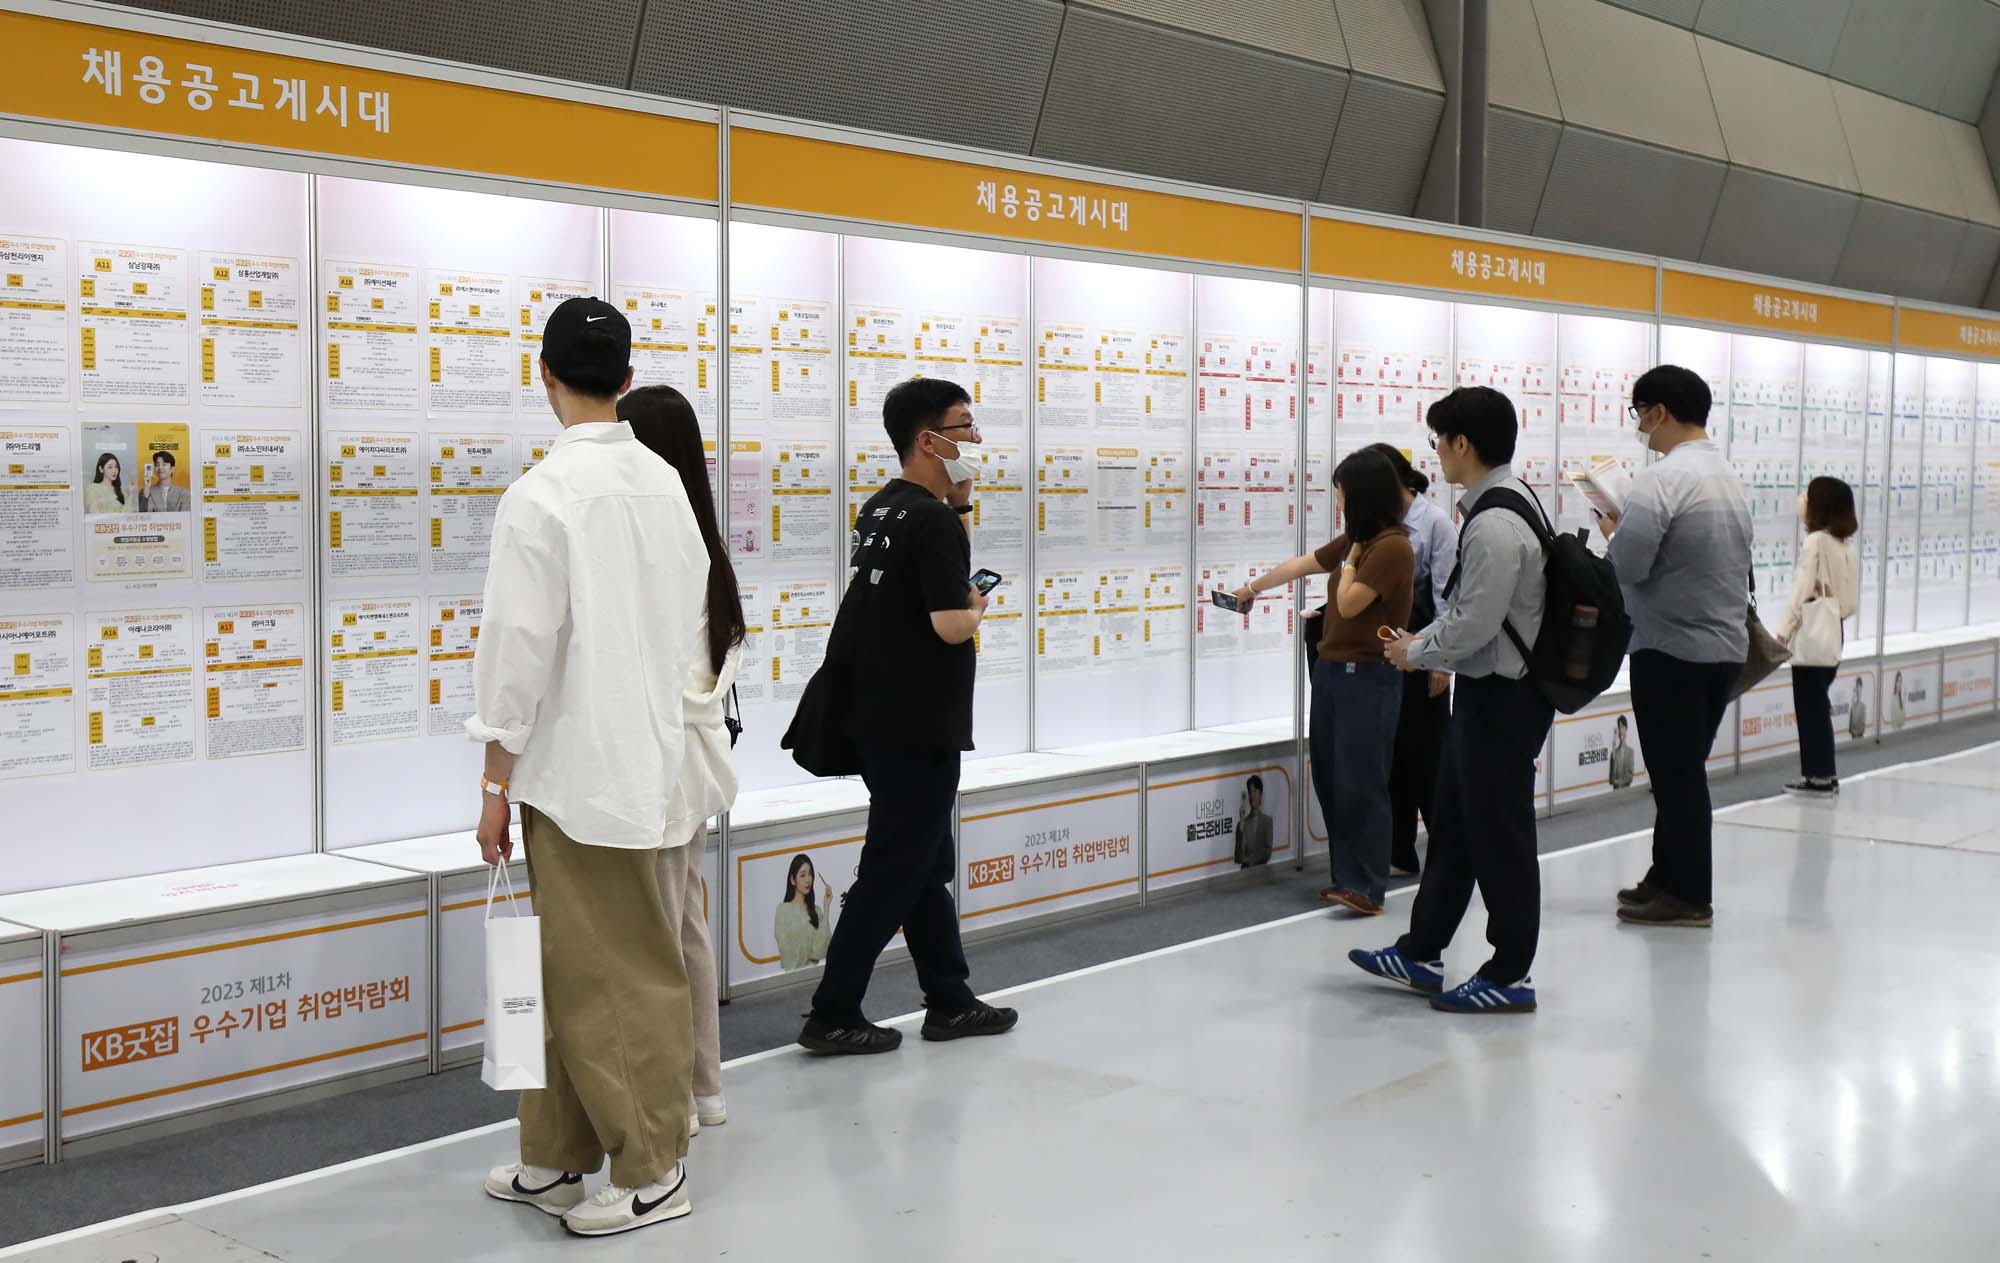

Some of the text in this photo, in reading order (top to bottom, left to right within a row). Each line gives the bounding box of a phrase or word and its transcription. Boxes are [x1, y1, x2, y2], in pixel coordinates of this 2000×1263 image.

[82, 47, 391, 134] 채용공고게시대
[976, 180, 1128, 232] 채용공고게시대
[1450, 249, 1545, 285] 채용공고게시대
[1196, 799, 1224, 819] 내일의
[1025, 828, 1070, 848] 2023 제1차
[1186, 817, 1233, 842] 출근준비로
[969, 835, 1130, 886] KB굿잡 우수기업 취업박람회
[200, 971, 292, 1005] 2023 제1차
[83, 975, 410, 1065] KB굿잡 우수기업 취업박람회
